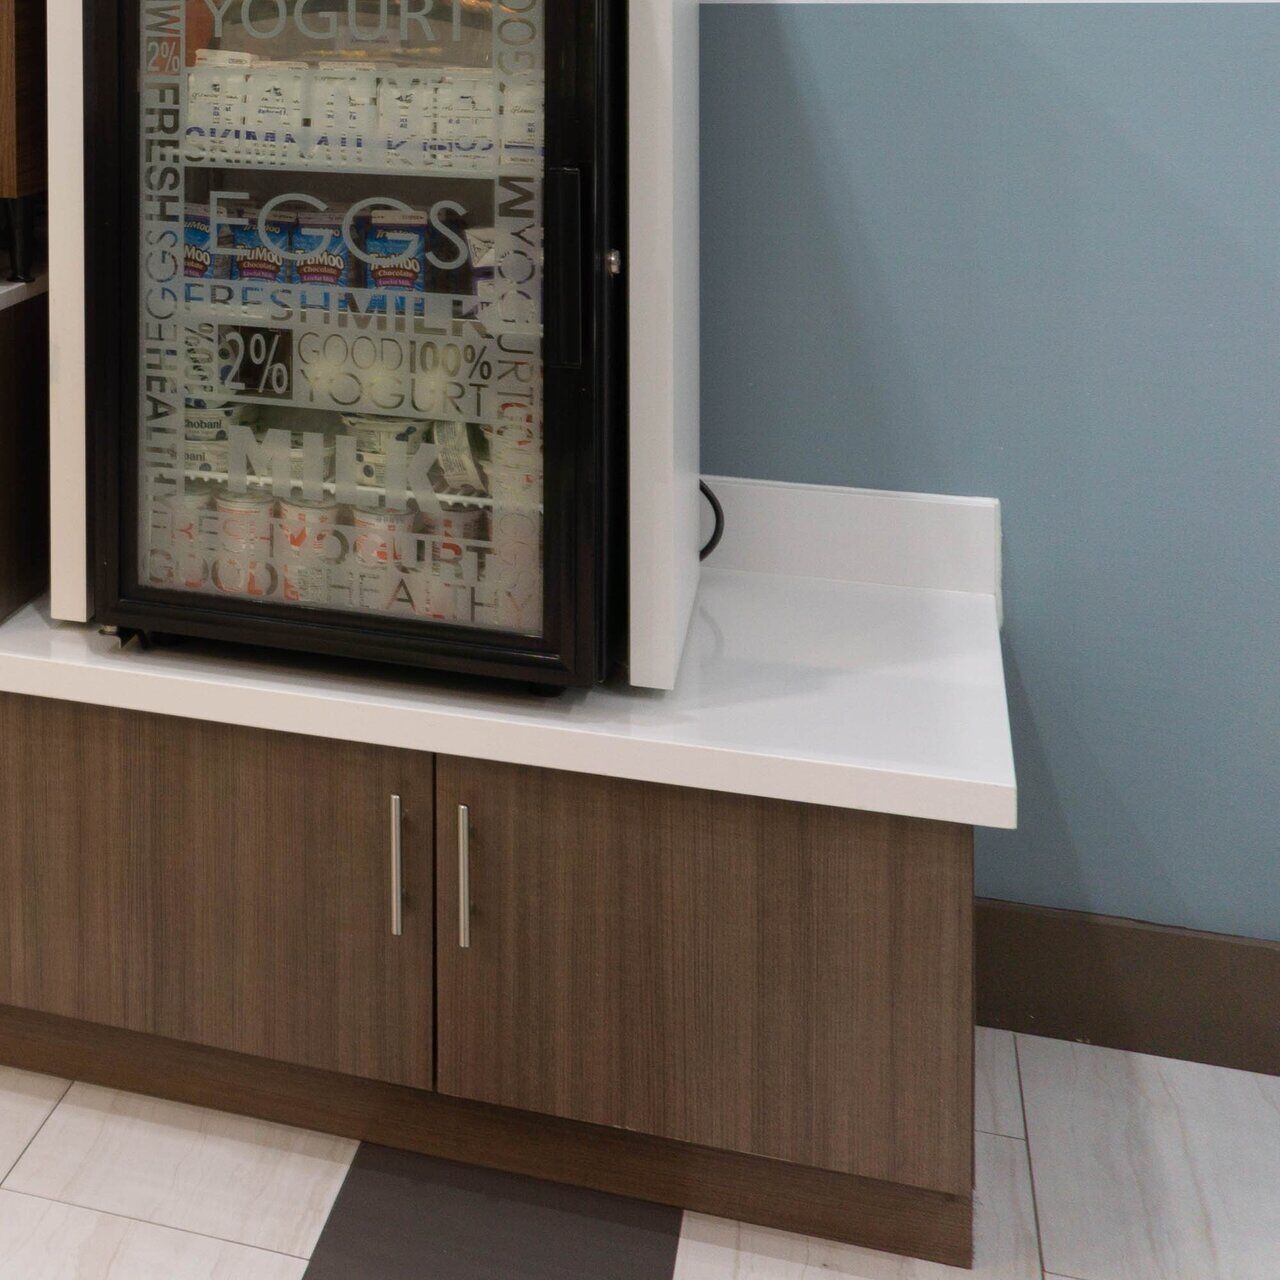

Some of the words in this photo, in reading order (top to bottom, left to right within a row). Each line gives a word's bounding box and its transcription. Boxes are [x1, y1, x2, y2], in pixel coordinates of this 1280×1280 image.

[147, 41, 180, 74] 2%
[146, 81, 181, 223] FRESH
[208, 190, 472, 271] EGGS
[184, 282, 331, 325] FRESH
[337, 291, 495, 339] MILK
[224, 332, 289, 394] 2%
[297, 331, 403, 372] GOOD
[408, 338, 493, 380] 100%
[298, 367, 489, 417] YOGURT
[227, 425, 444, 513] MILK
